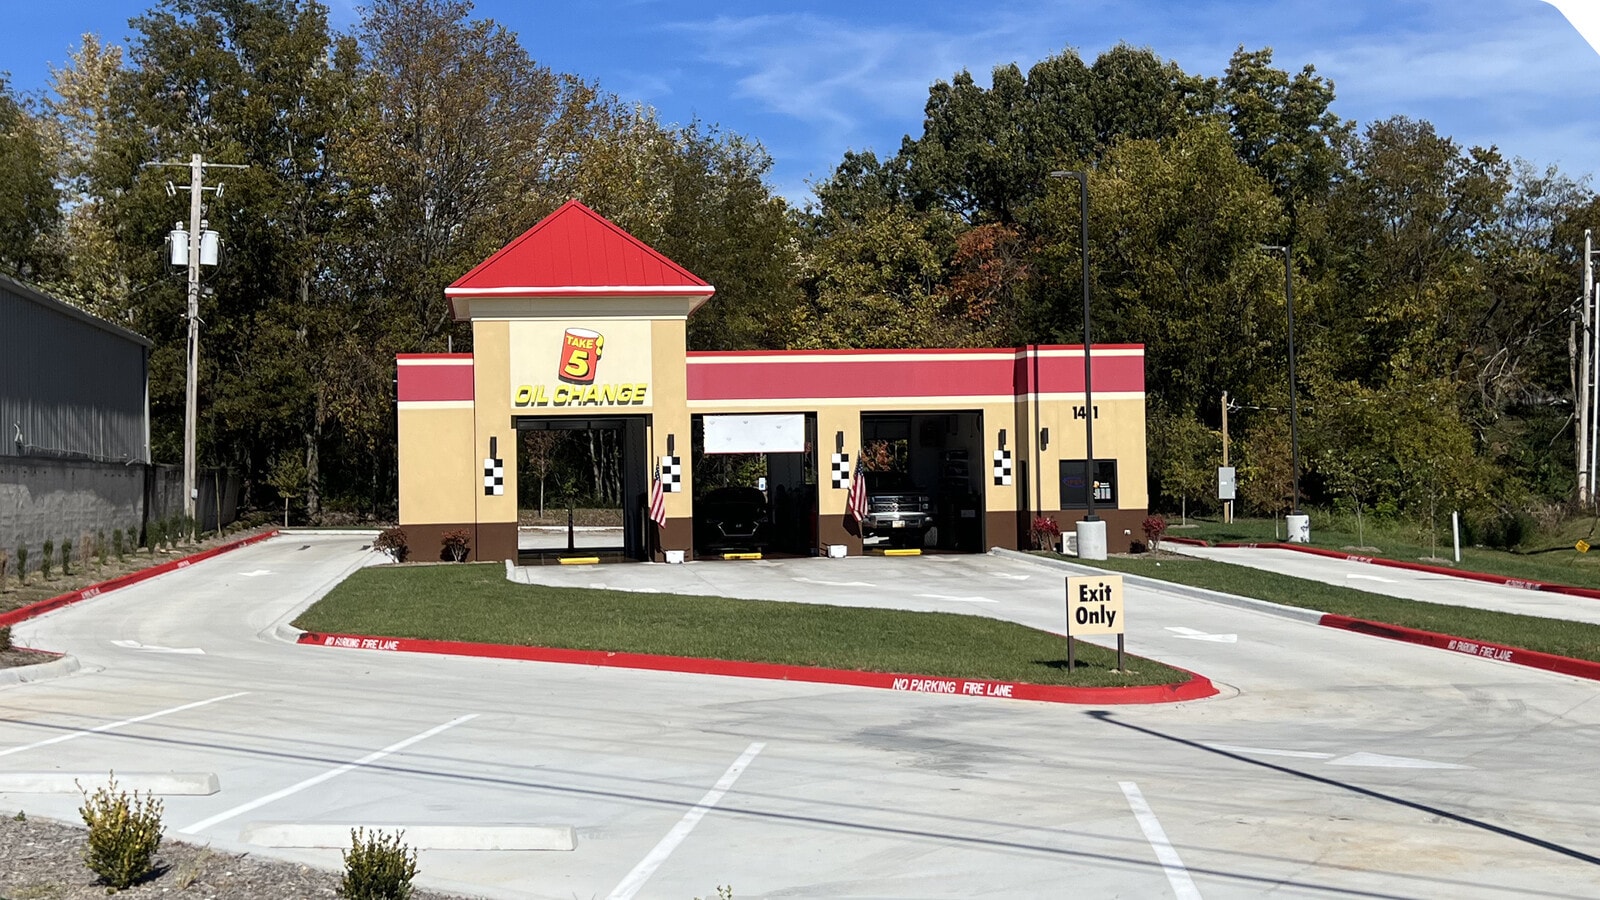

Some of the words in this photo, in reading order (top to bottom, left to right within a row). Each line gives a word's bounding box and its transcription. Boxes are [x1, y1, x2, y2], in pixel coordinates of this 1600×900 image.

[566, 335, 594, 349] TAKE
[564, 349, 590, 377] 5
[515, 384, 548, 406] OIL
[553, 382, 648, 406] CHANGE
[1072, 406, 1098, 419] 141
[1079, 582, 1112, 602] Exit
[1076, 604, 1116, 628] Only
[324, 636, 335, 646] NO
[361, 639, 379, 650] FIRE
[378, 640, 400, 651] LANE
[1478, 645, 1496, 658] FIRE
[1493, 648, 1513, 661] LANE
[892, 678, 909, 691] NO
[909, 679, 957, 694] PARKING
[962, 681, 985, 695] FIRE
[986, 683, 1014, 698] LANE
